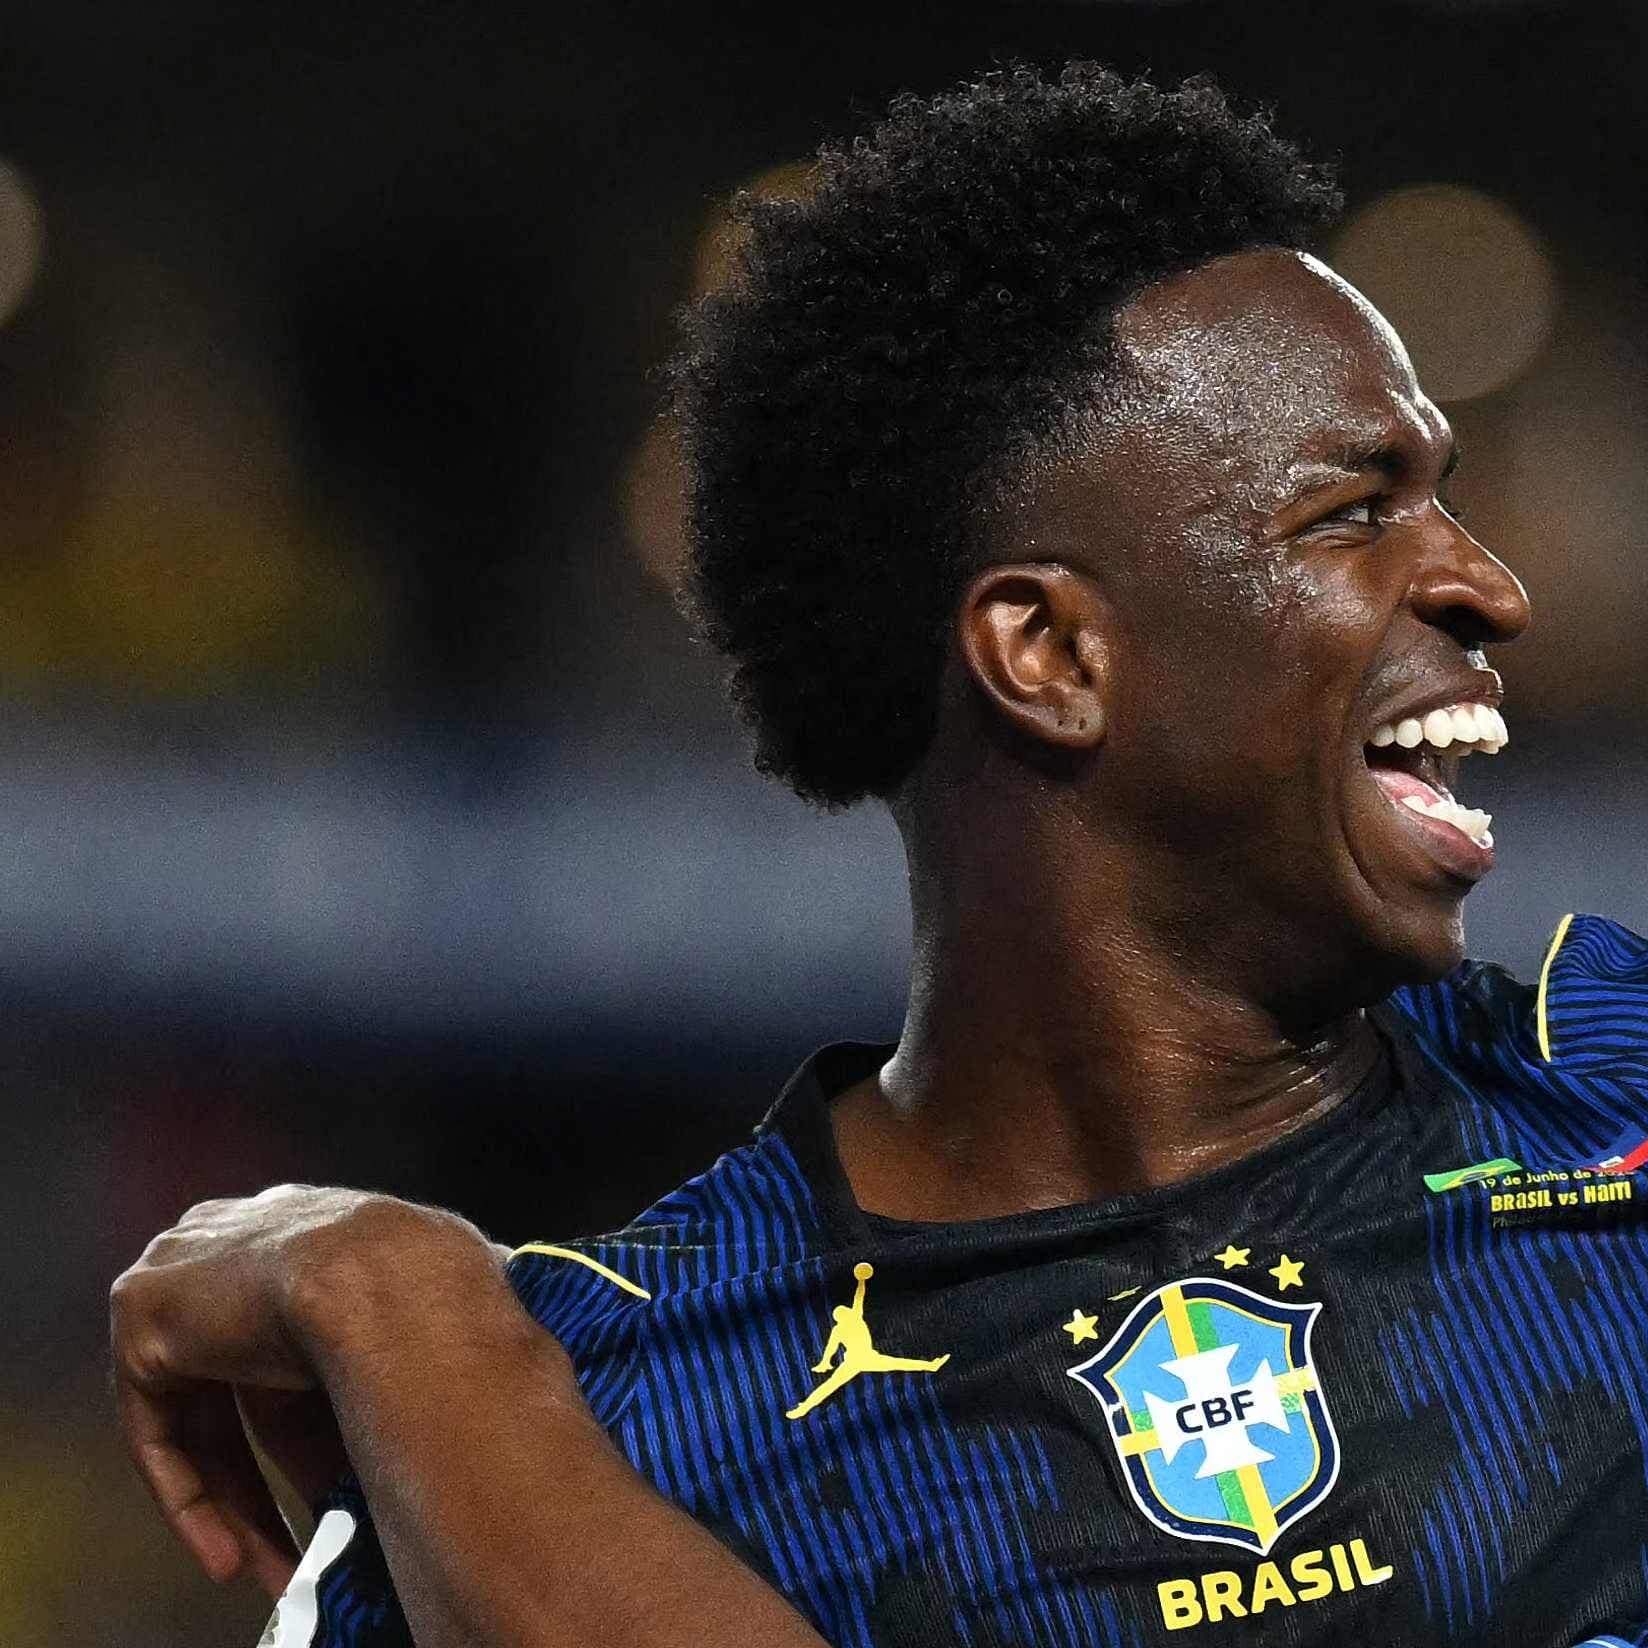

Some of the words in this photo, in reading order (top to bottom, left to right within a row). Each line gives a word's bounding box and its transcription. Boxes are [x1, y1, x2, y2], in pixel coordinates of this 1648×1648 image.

[1480, 1177, 1496, 1190] 19
[1502, 1174, 1522, 1186] de
[1526, 1169, 1569, 1184] Junho
[1573, 1168, 1592, 1179] de
[1557, 1190, 1579, 1206] vs
[1175, 1389, 1255, 1434] CBF
[1157, 1538, 1394, 1631] BRASIL
